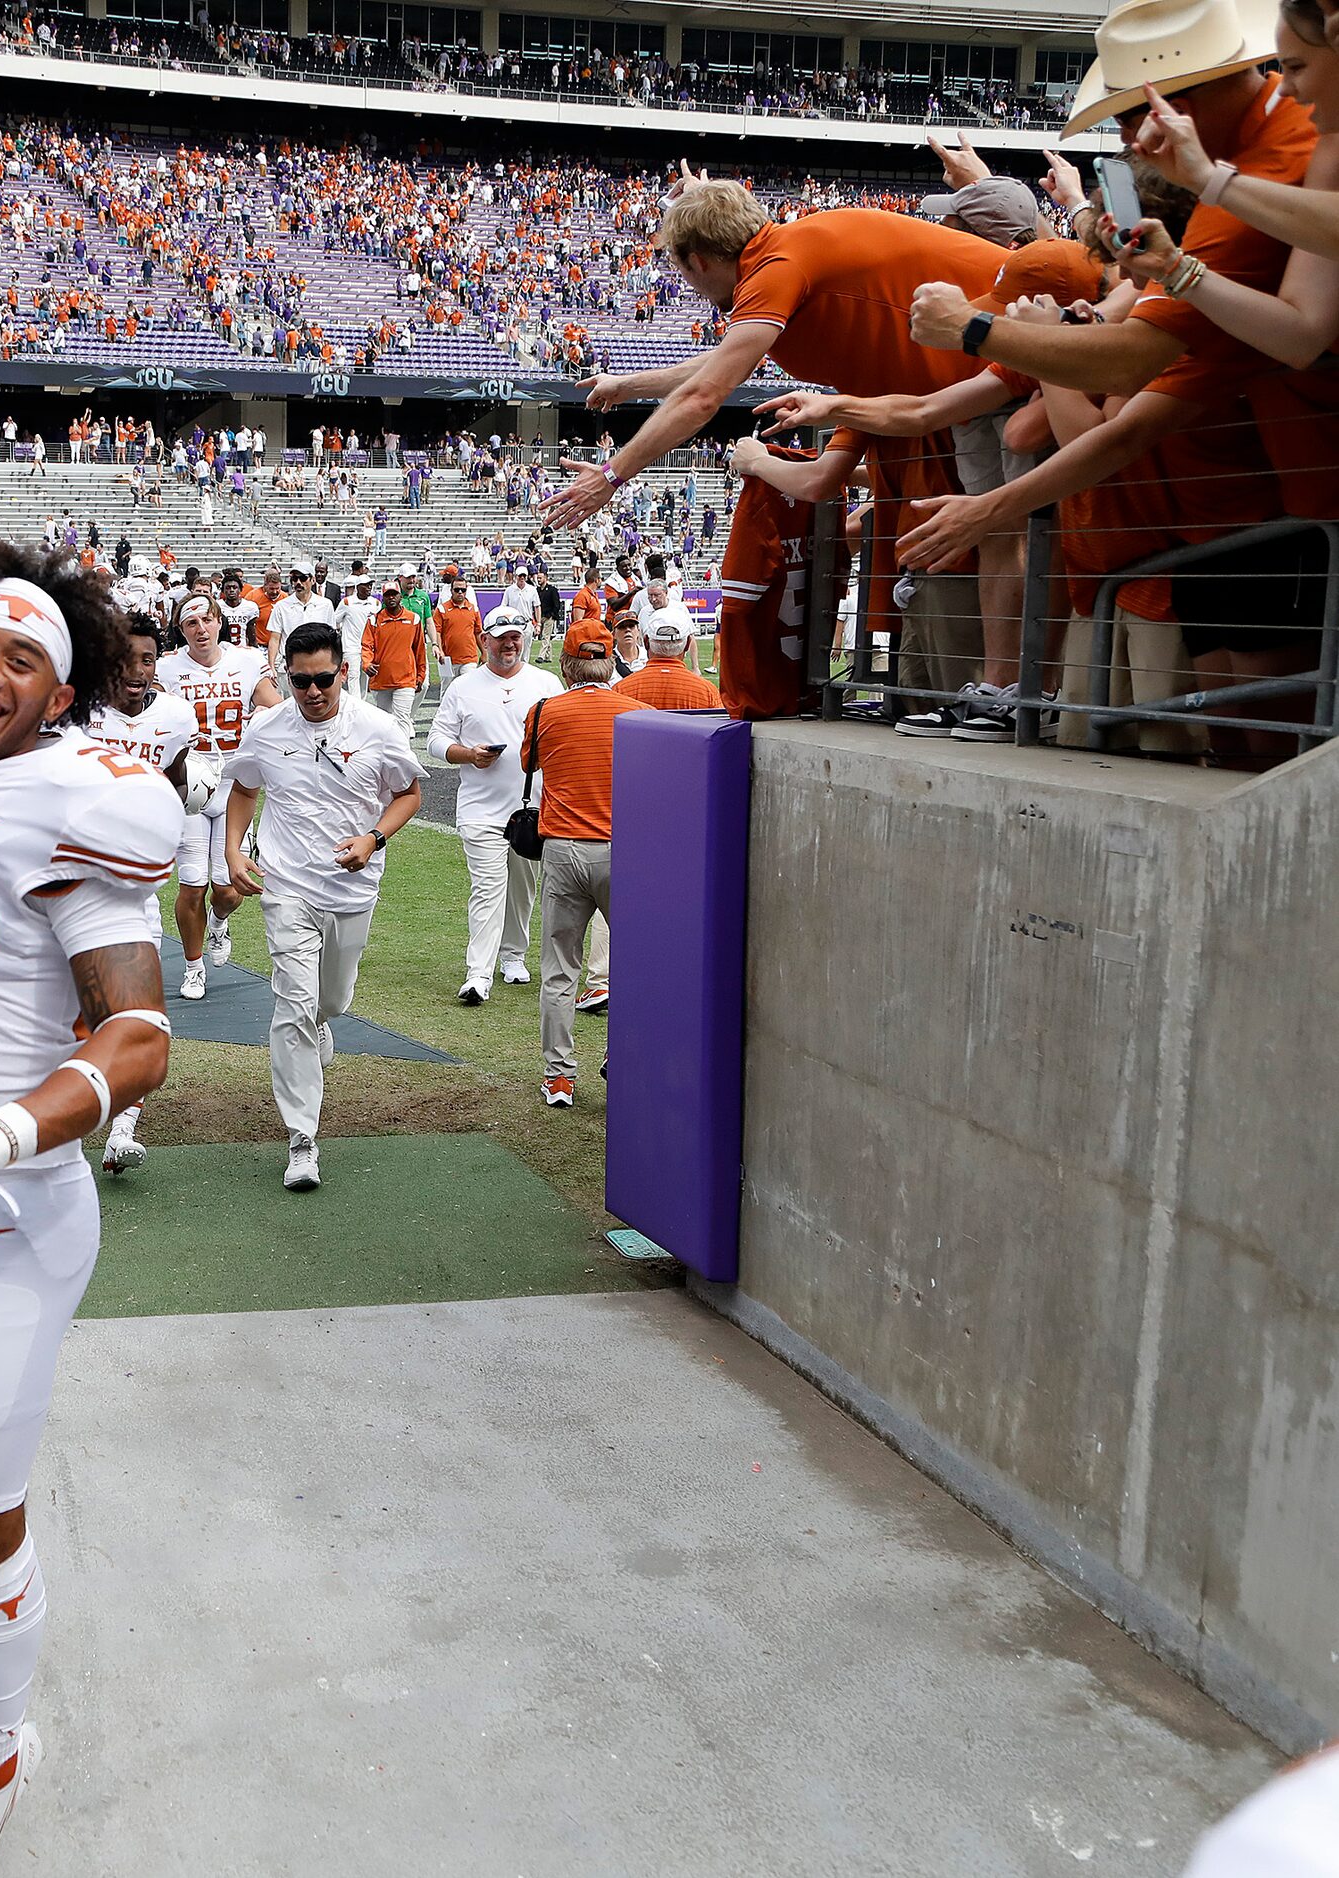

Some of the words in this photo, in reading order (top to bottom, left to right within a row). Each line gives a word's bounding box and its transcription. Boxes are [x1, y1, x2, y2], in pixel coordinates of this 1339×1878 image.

[135, 368, 174, 390] TCU
[311, 374, 350, 396] TCU
[479, 380, 513, 399] TCU
[227, 615, 248, 623] EXAS
[178, 674, 191, 682] XII
[180, 682, 242, 701] TEXAS
[193, 700, 244, 752] 19
